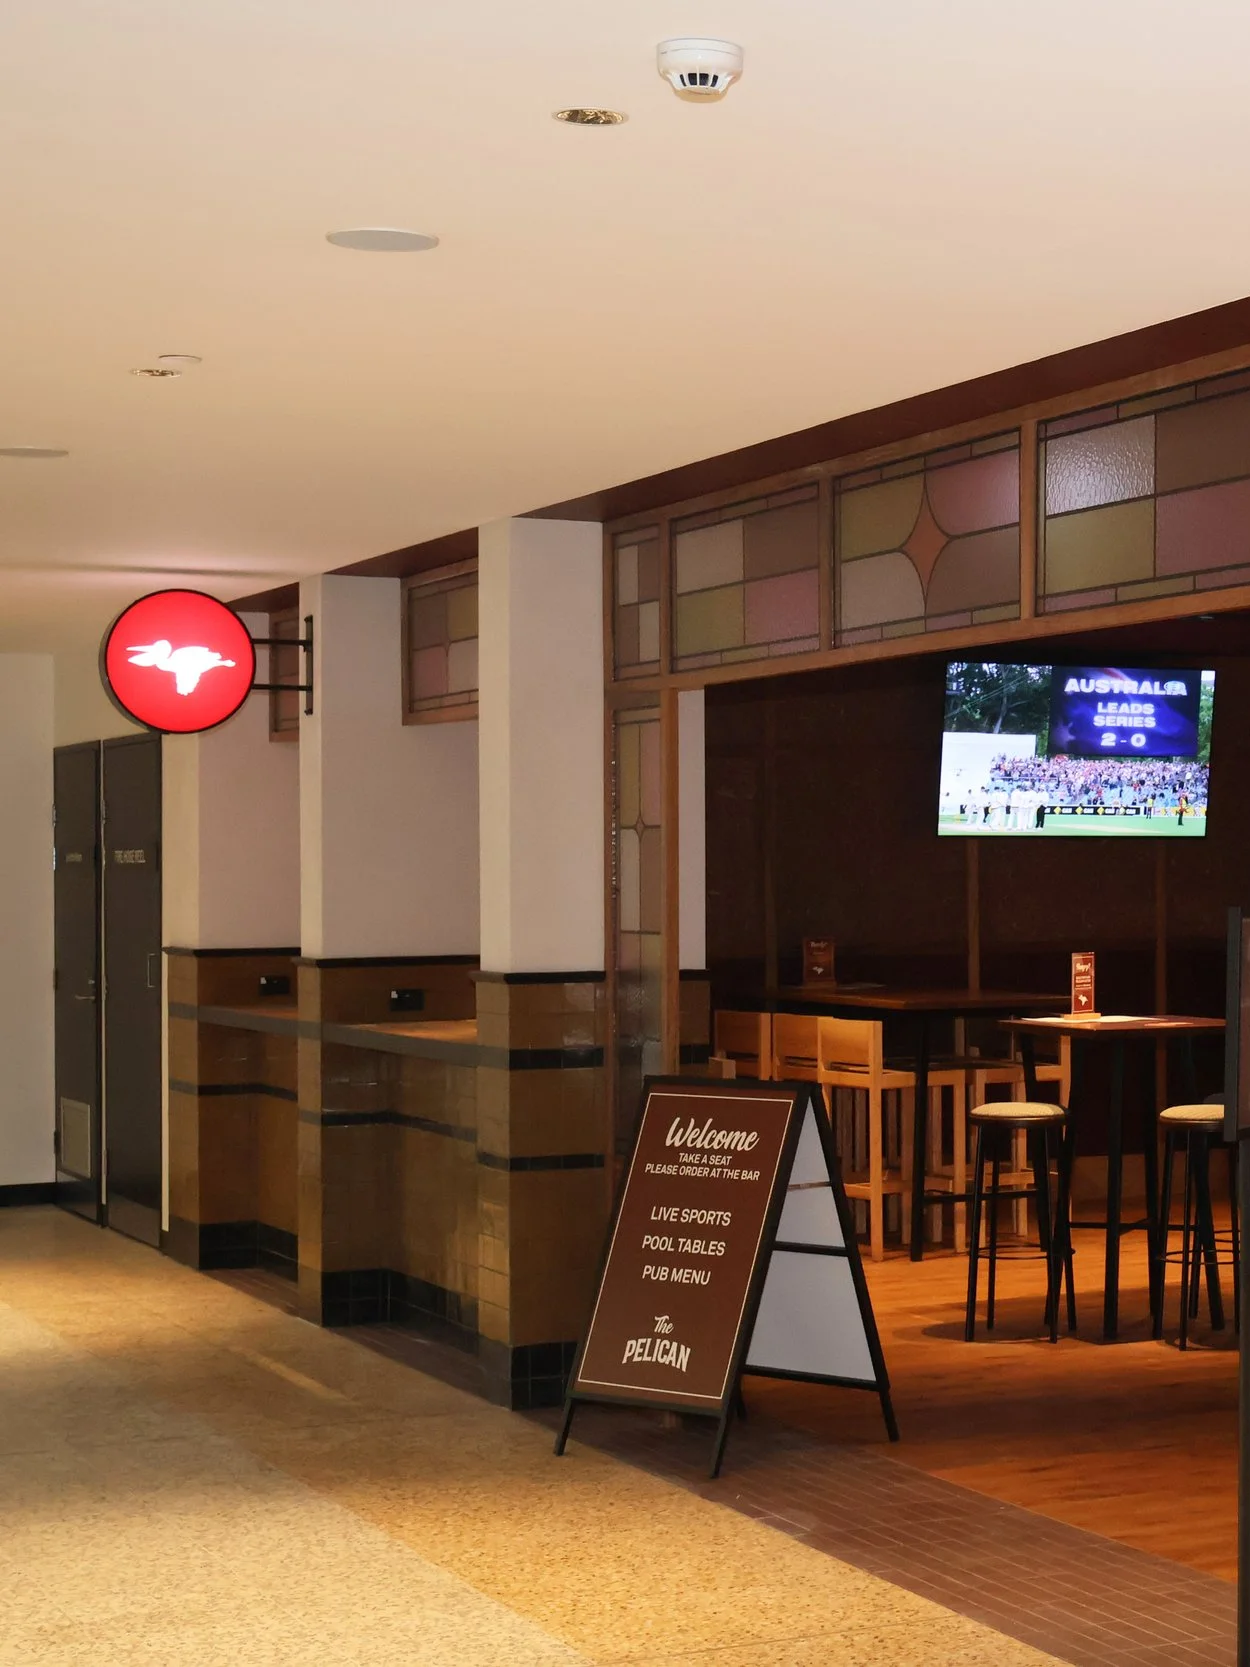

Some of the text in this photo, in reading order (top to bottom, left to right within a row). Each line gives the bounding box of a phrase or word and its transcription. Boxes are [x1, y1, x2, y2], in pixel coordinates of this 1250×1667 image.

[1097, 702, 1155, 715] LEADS
[1093, 715, 1156, 728] SERIES
[1100, 732, 1117, 747] 2
[1130, 733, 1147, 748] 0
[665, 1117, 760, 1151] Welcome
[678, 1152, 732, 1166] TAKE A SEAT
[645, 1163, 760, 1181] PLEASE ORDER AT THE BAR
[650, 1206, 732, 1227] LIVE SPORTS
[642, 1235, 726, 1256] POOL TABLES
[642, 1265, 711, 1285] PUB MENU
[654, 1315, 674, 1334] The
[622, 1338, 691, 1372] PELICAN
